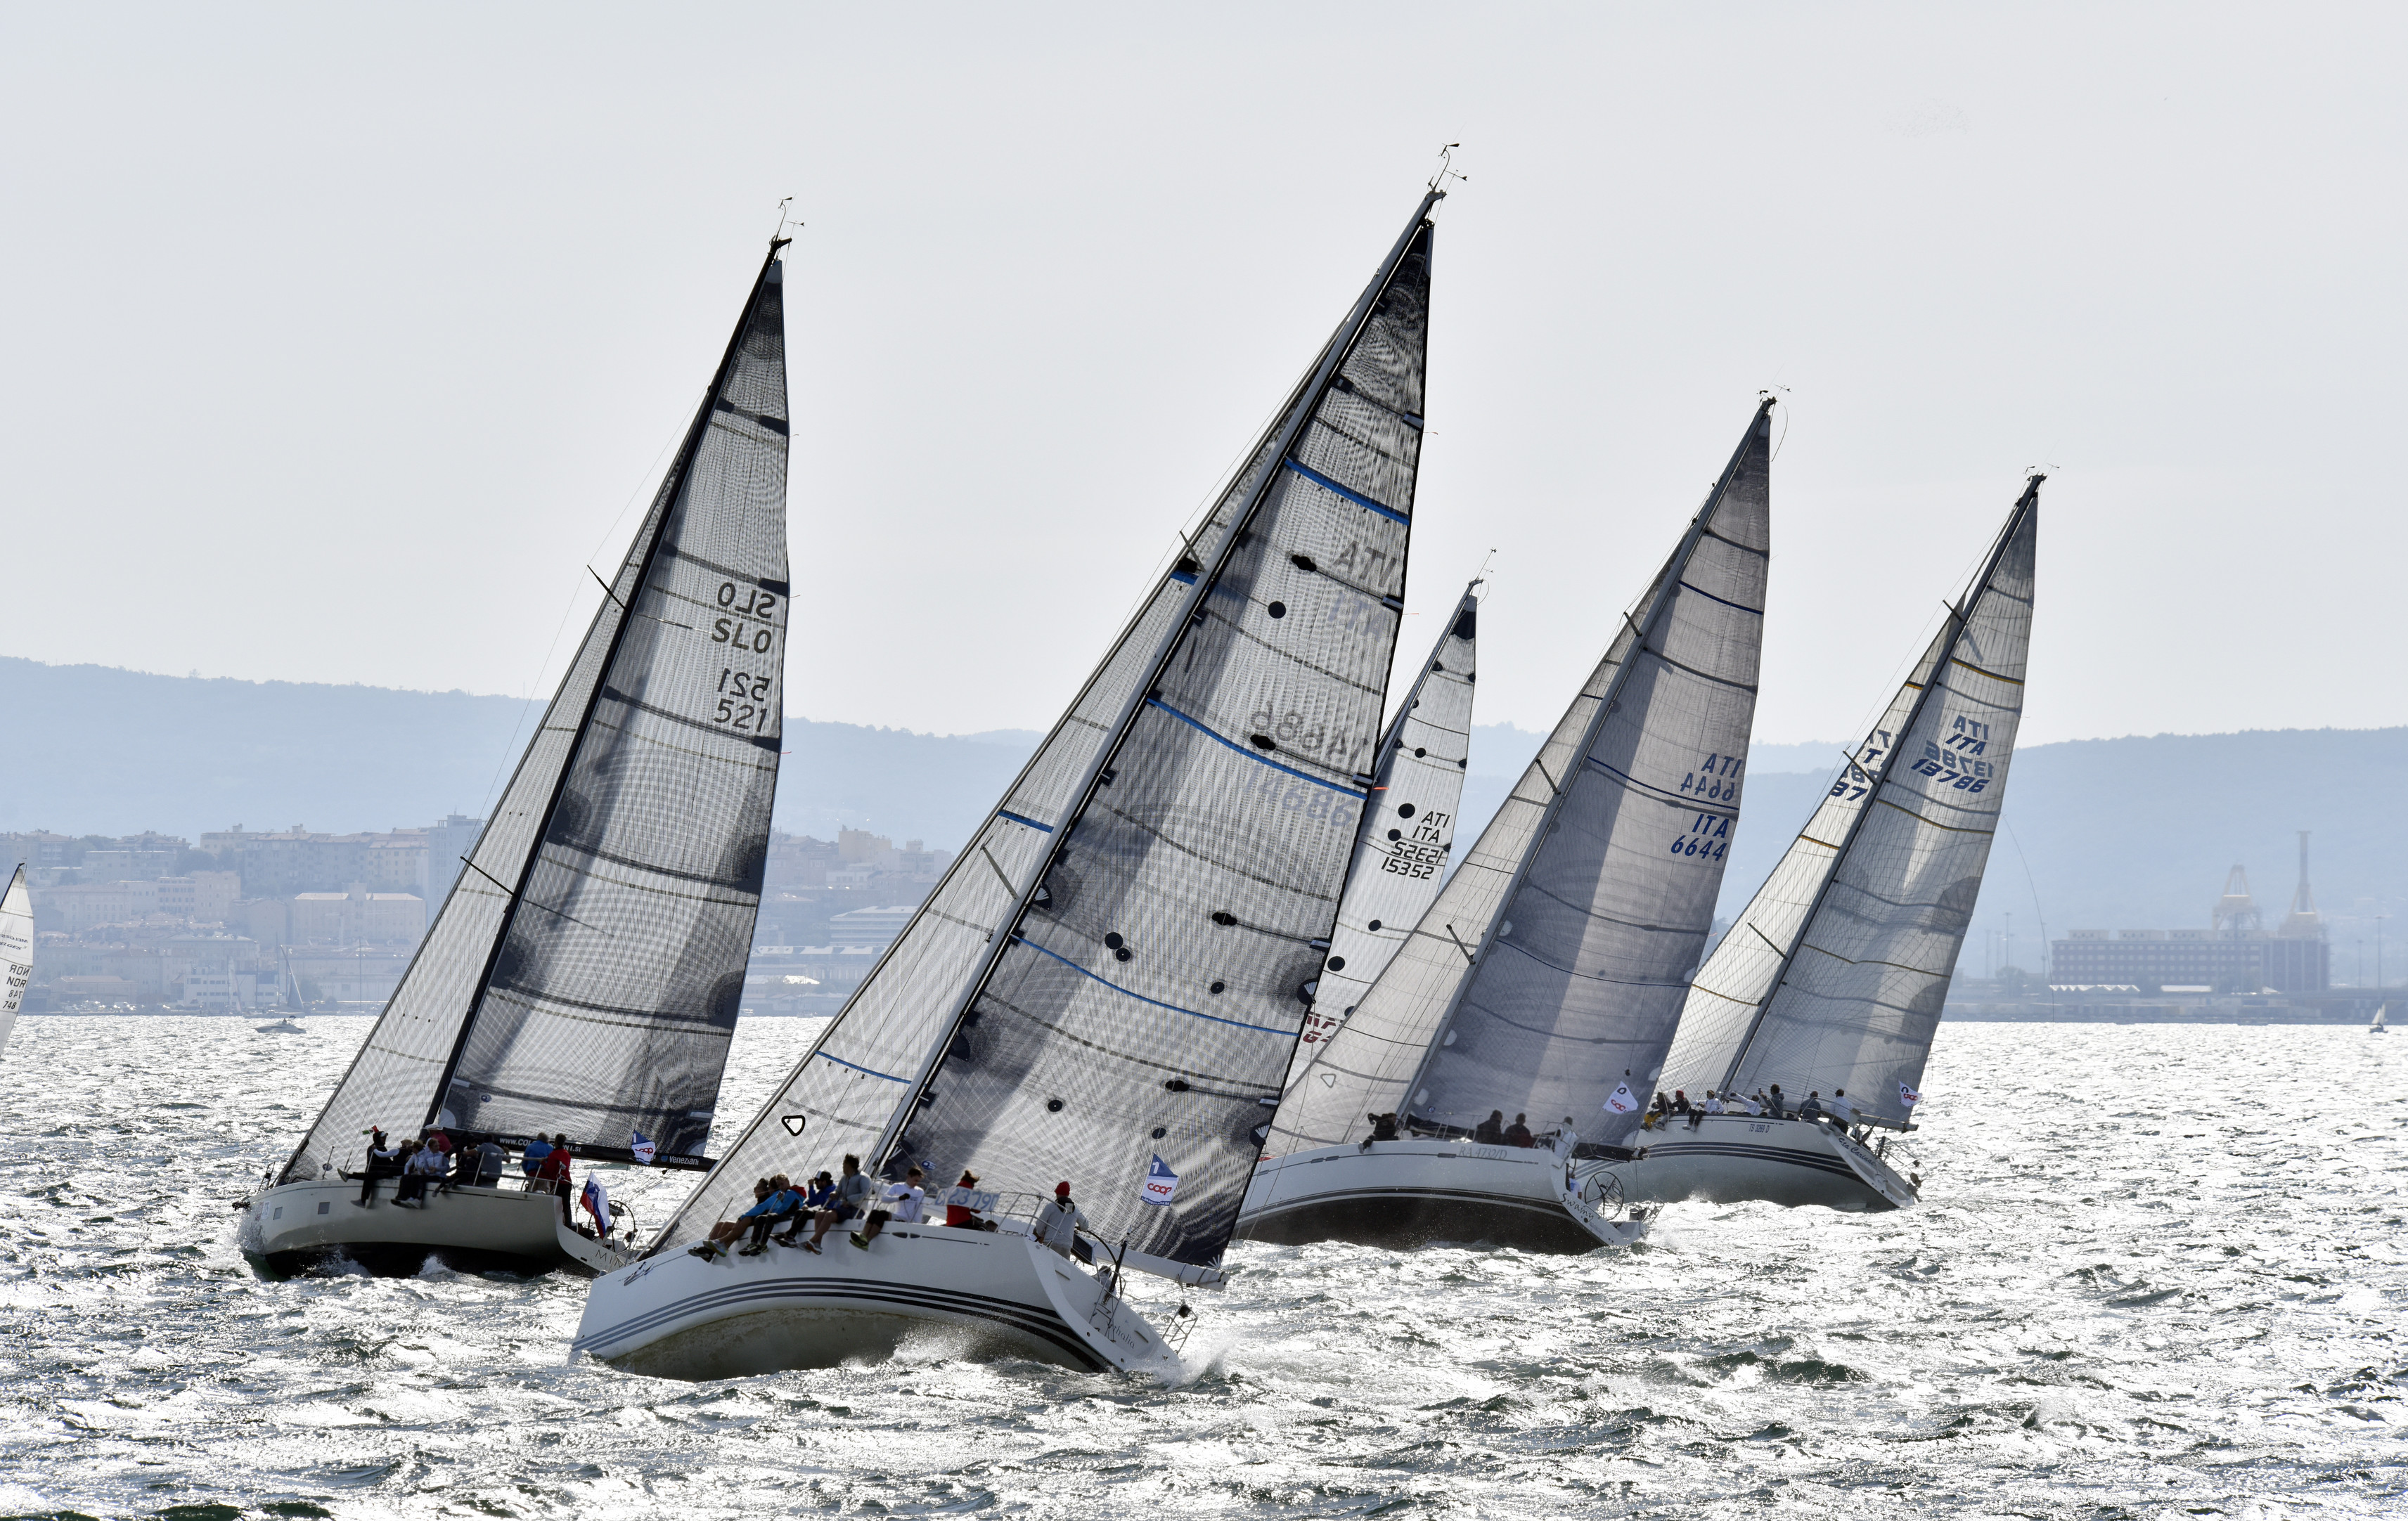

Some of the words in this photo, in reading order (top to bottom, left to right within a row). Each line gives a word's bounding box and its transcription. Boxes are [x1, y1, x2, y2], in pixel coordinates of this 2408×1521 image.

[711, 618, 772, 654] SLO
[713, 698, 767, 732] 521
[1945, 734, 1987, 756] ITA
[1911, 758, 1990, 793] 13786
[1412, 826, 1440, 843] ITA
[1692, 814, 1730, 838] ITA
[1671, 835, 1727, 861] 6644
[1381, 857, 1434, 879] 15352
[6, 976, 27, 988] NOR
[3, 1001, 17, 1009] 748
[1152, 1161, 1160, 1174] 1
[1147, 1183, 1172, 1196] coop
